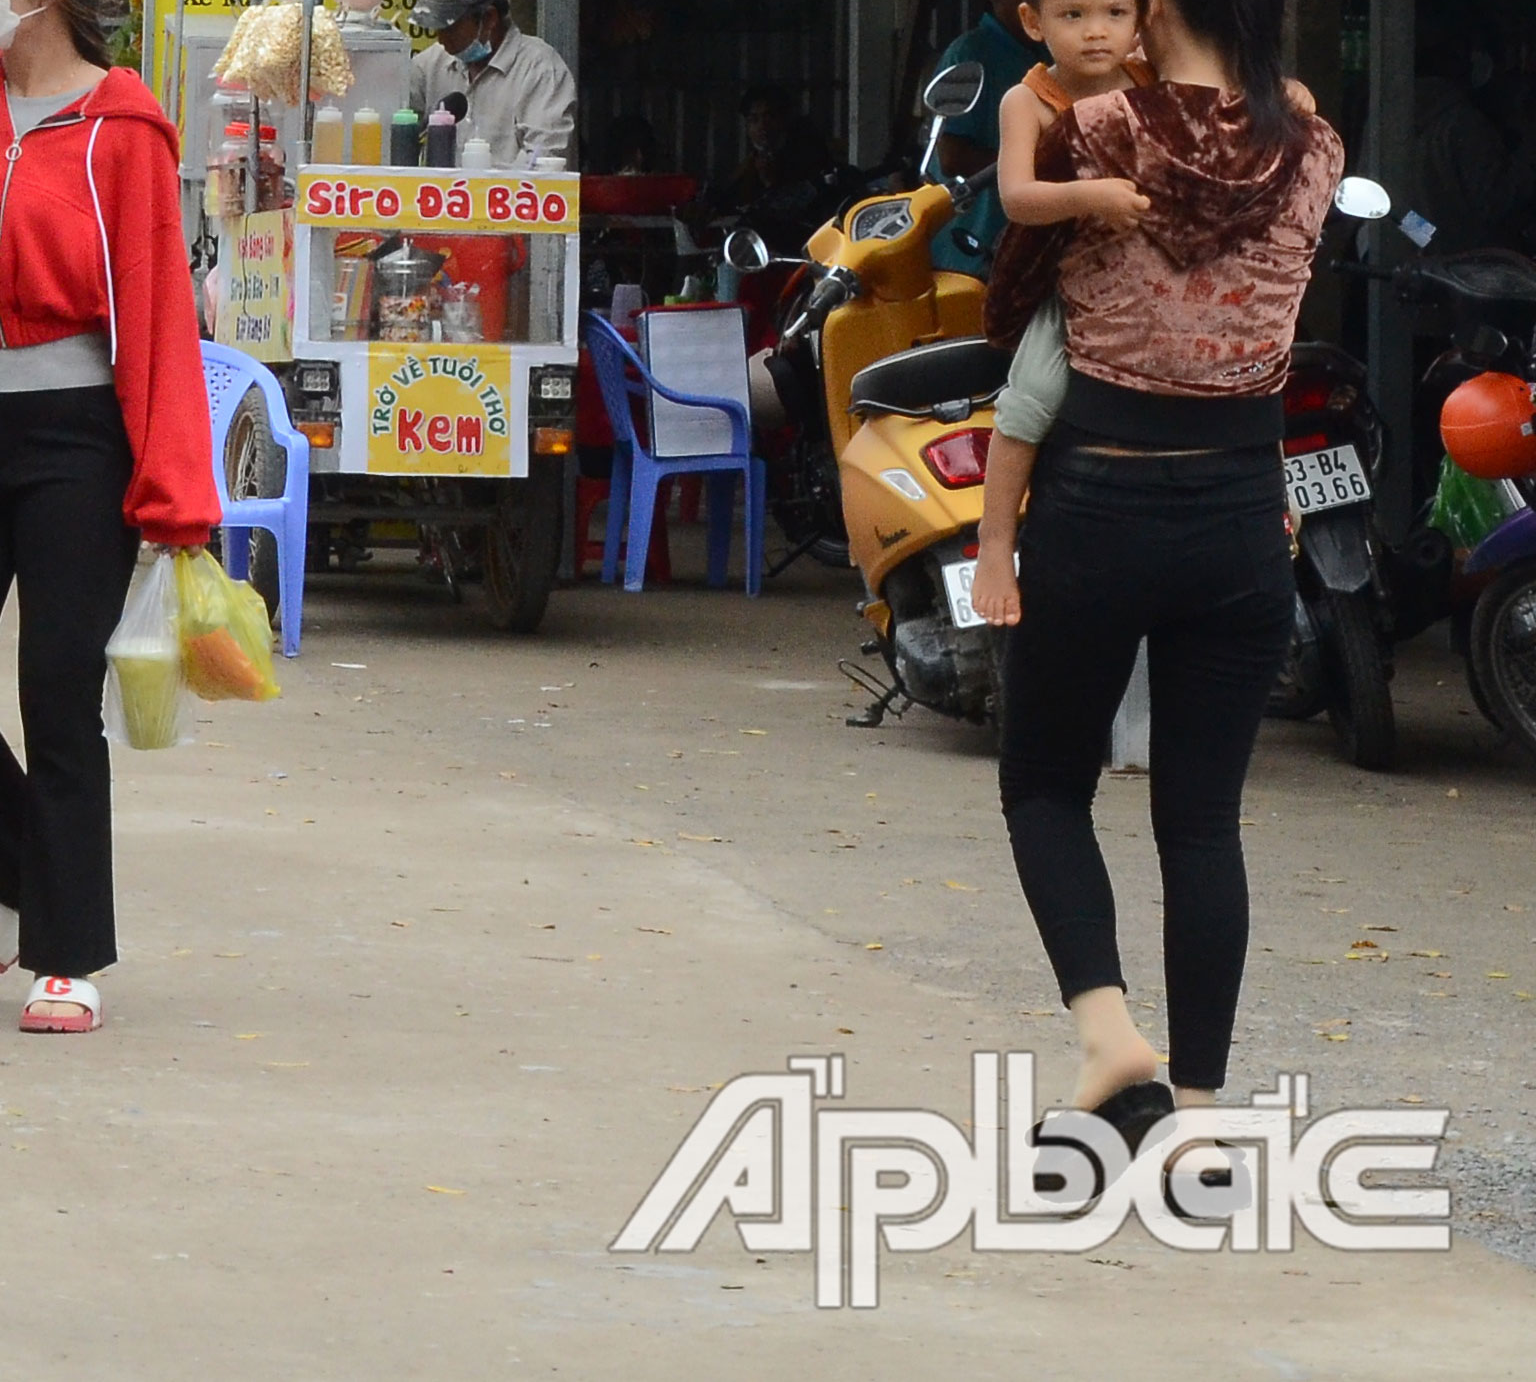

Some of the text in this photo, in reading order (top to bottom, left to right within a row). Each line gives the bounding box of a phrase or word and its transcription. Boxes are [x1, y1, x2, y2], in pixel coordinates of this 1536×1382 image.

[307, 179, 567, 222] Siro Đá Bào
[372, 356, 506, 436] TRỞ VỀ TUỔI THƠ
[398, 407, 482, 454] Kem
[1294, 473, 1366, 509] 03.66
